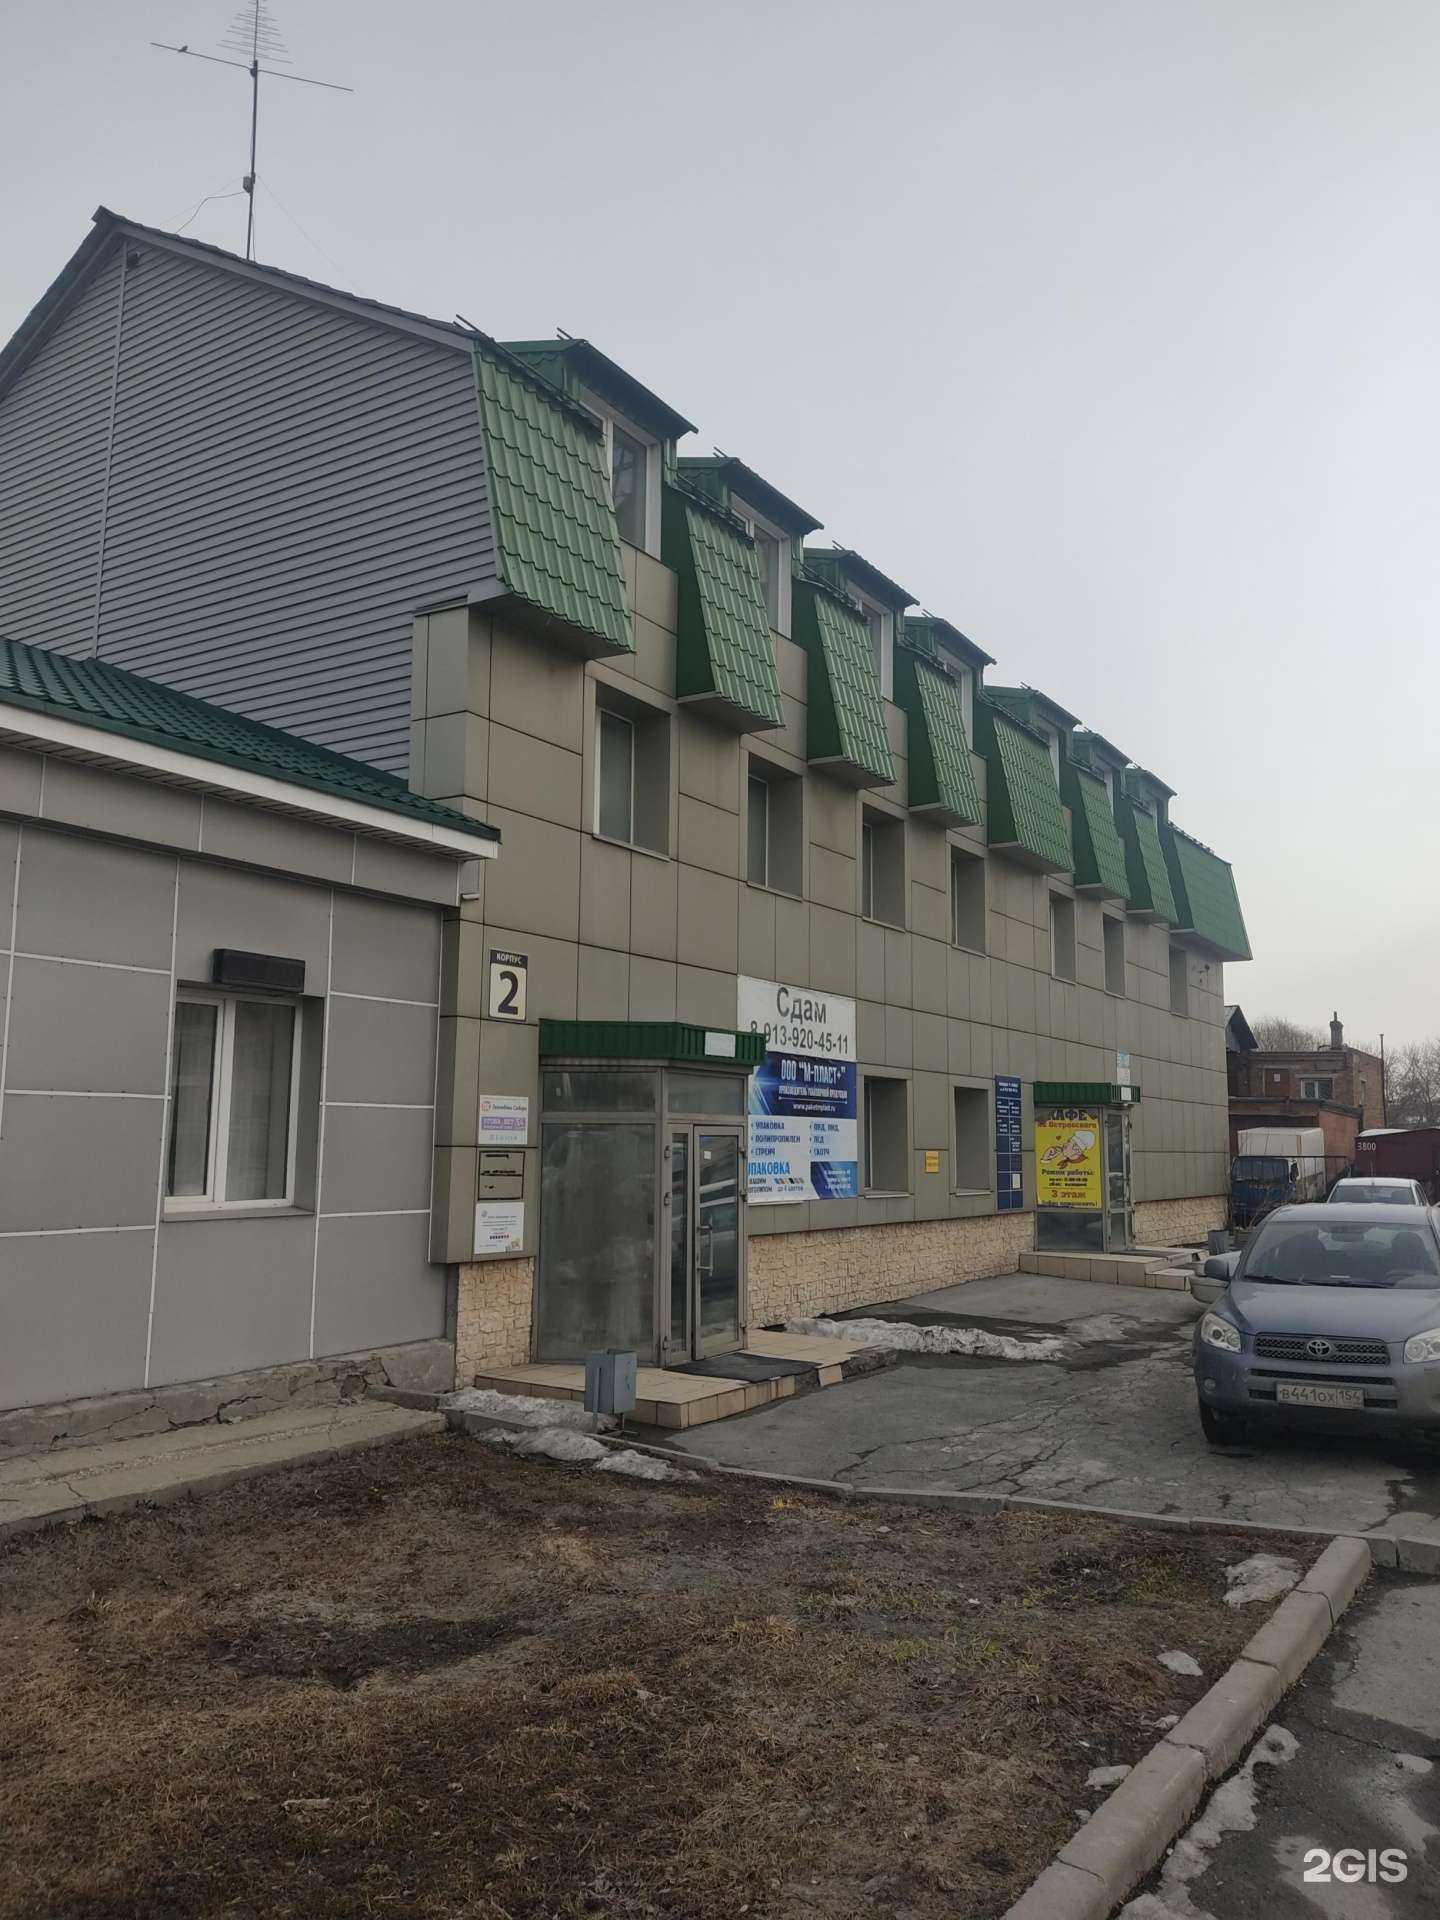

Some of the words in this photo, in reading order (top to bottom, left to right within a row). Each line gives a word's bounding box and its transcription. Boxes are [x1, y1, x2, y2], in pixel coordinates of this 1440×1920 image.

[496, 953, 523, 965] КОРПУС
[498, 971, 519, 1015] 2
[777, 987, 827, 1025] Сдам
[781, 1059, 797, 1081] ООО
[755, 1121, 784, 1130] УПАКОВКА
[755, 1135, 800, 1143] ПОЛИПРОПИЛЕН
[1357, 1142, 1377, 1151] 3800
[748, 1162, 791, 1175] ПАКОВКА
[1051, 1189, 1058, 1198] 3
[1060, 1191, 1087, 1199] этаж
